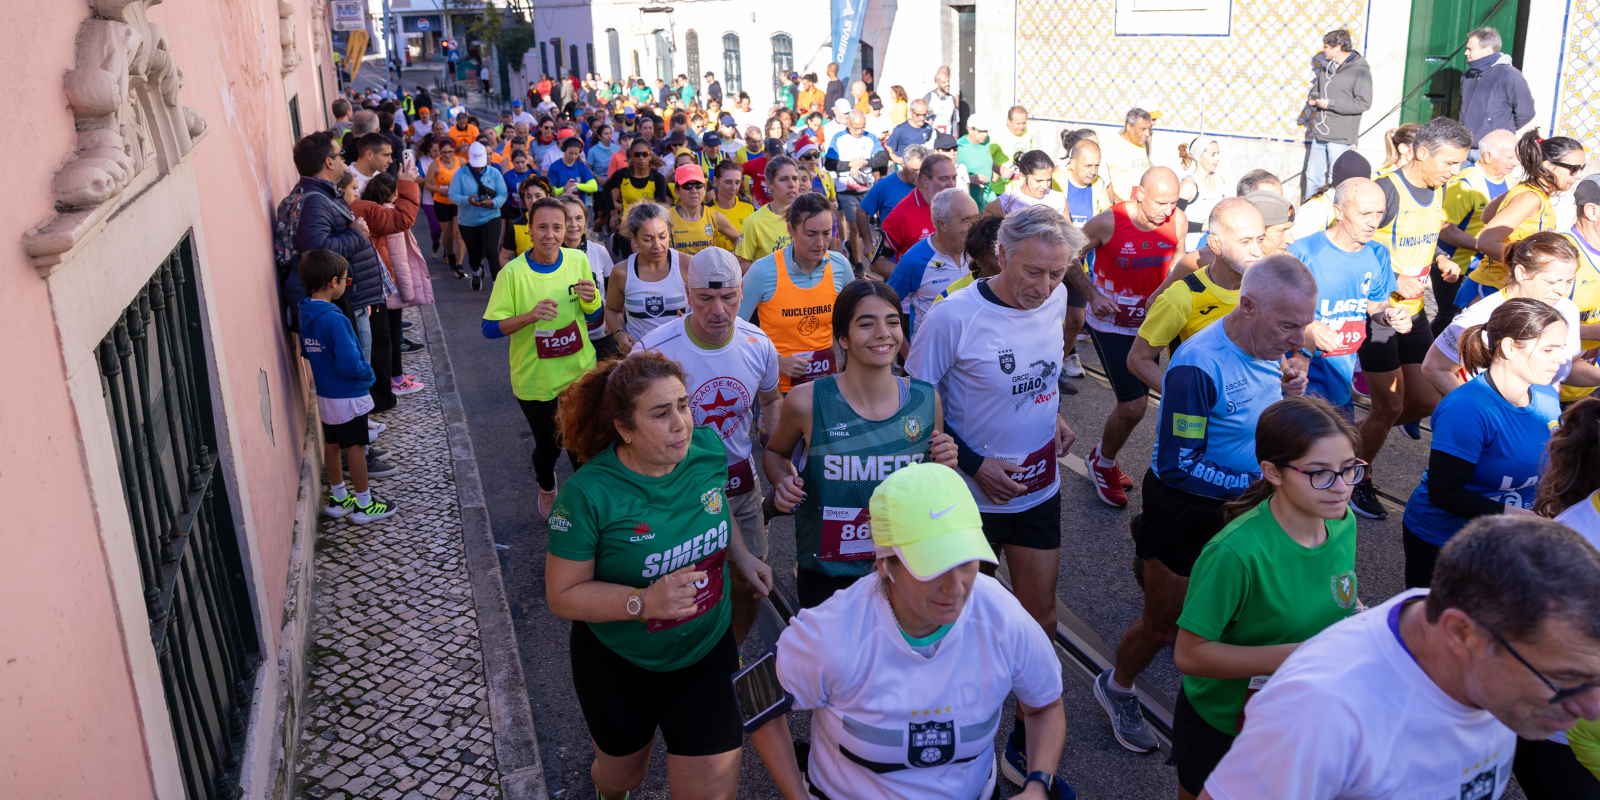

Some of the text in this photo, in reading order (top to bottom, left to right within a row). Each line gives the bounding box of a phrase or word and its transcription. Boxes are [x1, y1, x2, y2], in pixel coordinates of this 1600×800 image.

[836, 19, 853, 63] OEIRAS
[781, 304, 832, 317] NUCLEOEIRAS
[541, 331, 577, 348] 1204
[712, 380, 724, 388] DE
[1011, 373, 1030, 383] GRCD
[1011, 377, 1042, 396] LEIÃO
[823, 453, 925, 481] SIME
[630, 533, 656, 542] CLAW
[641, 520, 728, 579] SIMECQ
